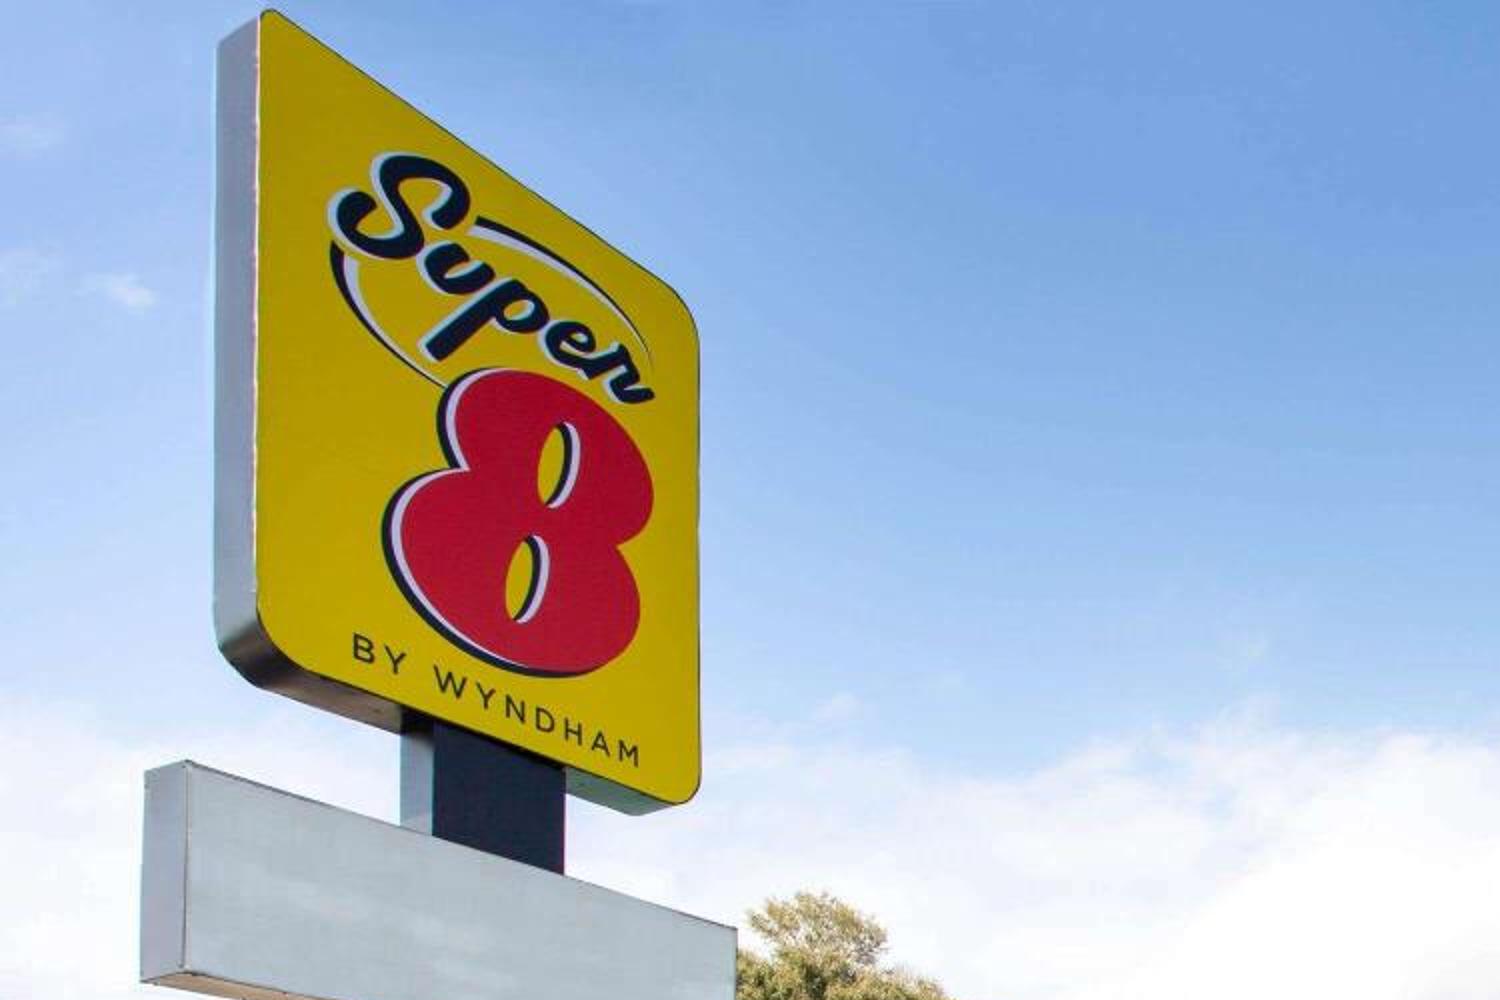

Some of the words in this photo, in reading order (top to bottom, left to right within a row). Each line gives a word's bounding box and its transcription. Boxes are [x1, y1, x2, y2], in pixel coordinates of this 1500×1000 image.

[326, 151, 655, 404] Super
[381, 367, 655, 678] 8
[352, 633, 407, 675] BY
[433, 663, 640, 767] WYNDHAM
